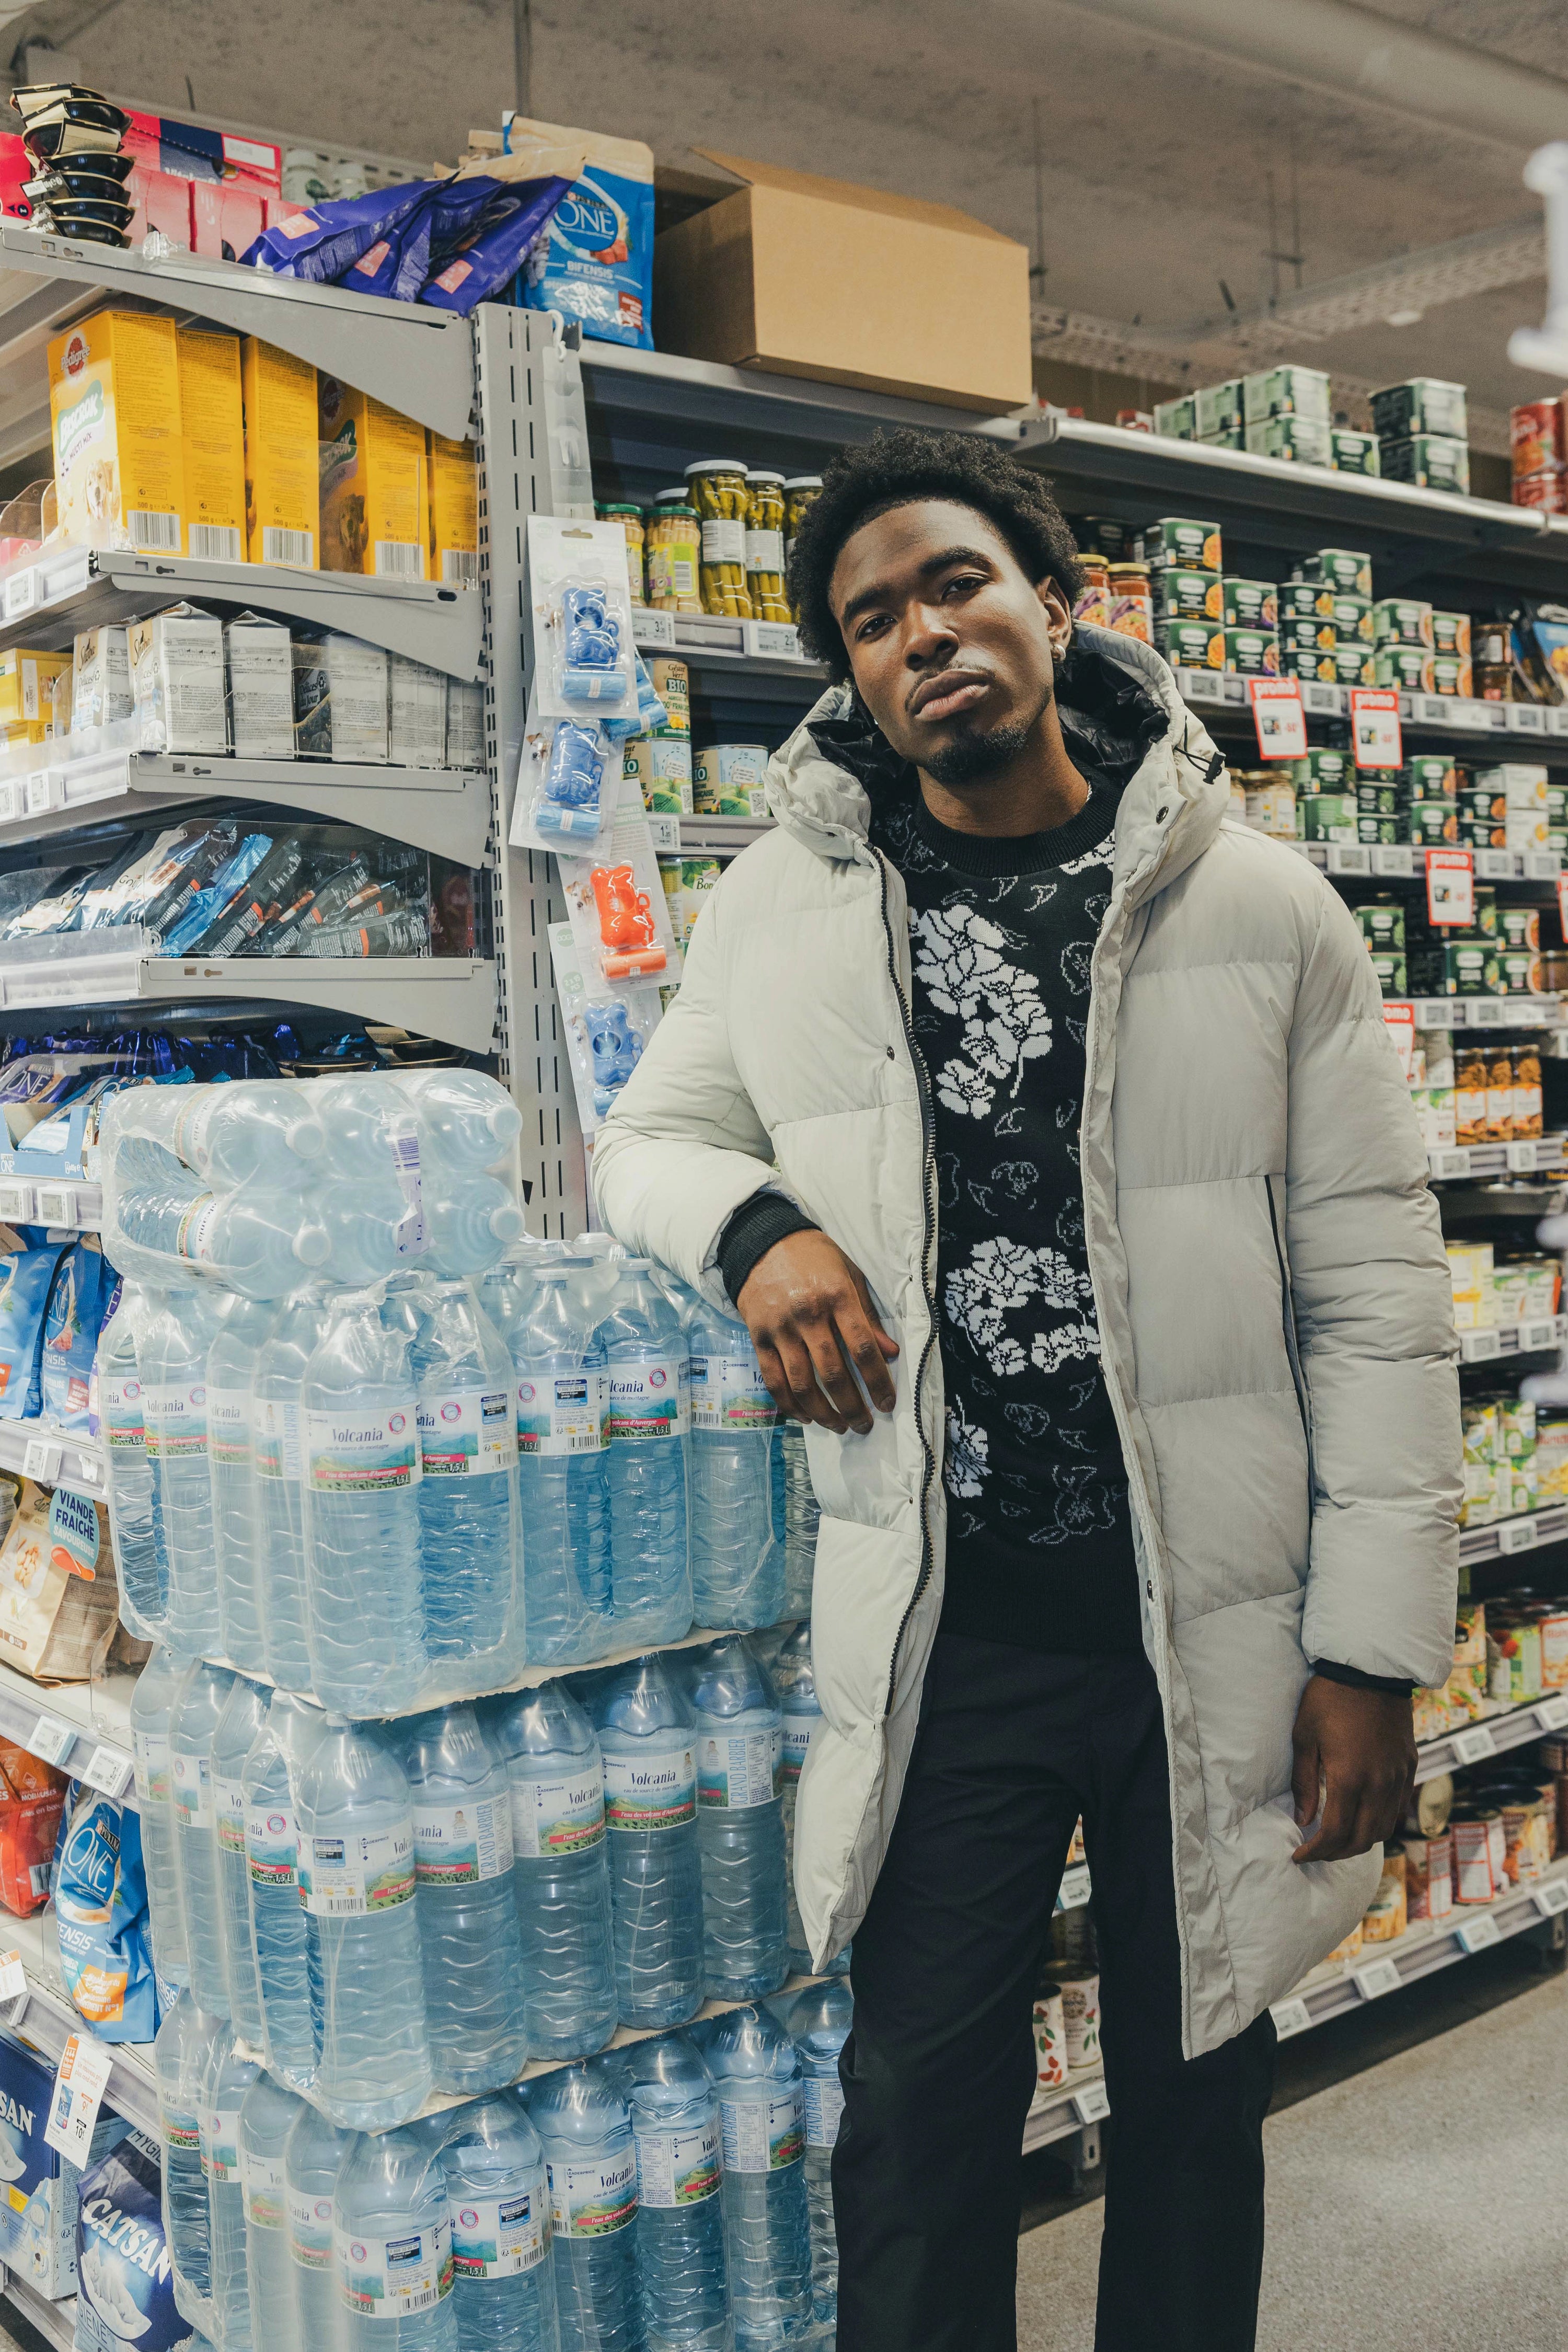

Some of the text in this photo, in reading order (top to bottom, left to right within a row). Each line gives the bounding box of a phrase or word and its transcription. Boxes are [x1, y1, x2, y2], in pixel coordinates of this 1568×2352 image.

[554, 199, 615, 235] ONE
[61, 345, 90, 371] Pedigree
[70, 432, 93, 459] MULTI MIX
[668, 664, 686, 672] Géant
[668, 679, 686, 693] BIO
[1253, 678, 1297, 698] promo
[1354, 691, 1395, 710] promo
[1430, 851, 1469, 869] promo
[6, 1069, 51, 1097] ONE
[1, 1160, 14, 1173] ONE
[610, 1379, 644, 1392] lcania
[630, 1419, 658, 1427] d'Auvergne
[655, 1425, 665, 1435] 1,5
[332, 1427, 383, 1443] Volcania
[524, 1442, 533, 1451] 1,5
[347, 1470, 368, 1479] volcans
[368, 1468, 397, 1479] d'Auvergne
[449, 1463, 459, 1473] 1,5
[60, 1489, 94, 1525] VIANDE
[53, 1525, 95, 1559] SAVOUREUSE
[728, 1738, 747, 1771] BARBIER
[631, 1769, 676, 1785] Volcania
[569, 1782, 601, 1805] Volcania
[662, 1783, 681, 1791] montagne
[730, 1773, 748, 1803] GRAND
[662, 1805, 685, 1816] d'Auvergne
[476, 1803, 494, 1841] BARBIER
[100, 1825, 120, 1853] PURINA
[360, 1836, 389, 1846] LEADERPRICE
[68, 1827, 114, 1893] ONE
[480, 1841, 498, 1874] GRAND
[275, 1873, 285, 1883] 1,5
[429, 1865, 456, 1873] d'Auvergne
[387, 1886, 399, 1895] l'eau
[57, 1921, 94, 1951] FENSIS
[804, 2079, 822, 2112] BARBIER
[768, 2100, 792, 2111] LEADERPRICE
[721, 2102, 737, 2136] BARBIER
[806, 2112, 824, 2141] GRAND
[130, 2129, 162, 2166] HYGI
[672, 2135, 699, 2145] LEADERPRICE
[723, 2136, 739, 2167] GRAND
[601, 2162, 634, 2188] Volcania
[608, 2186, 621, 2194] source
[613, 2208, 627, 2218] volcans
[82, 2198, 171, 2285] CATSAN
[469, 2266, 479, 2276] 1,5
